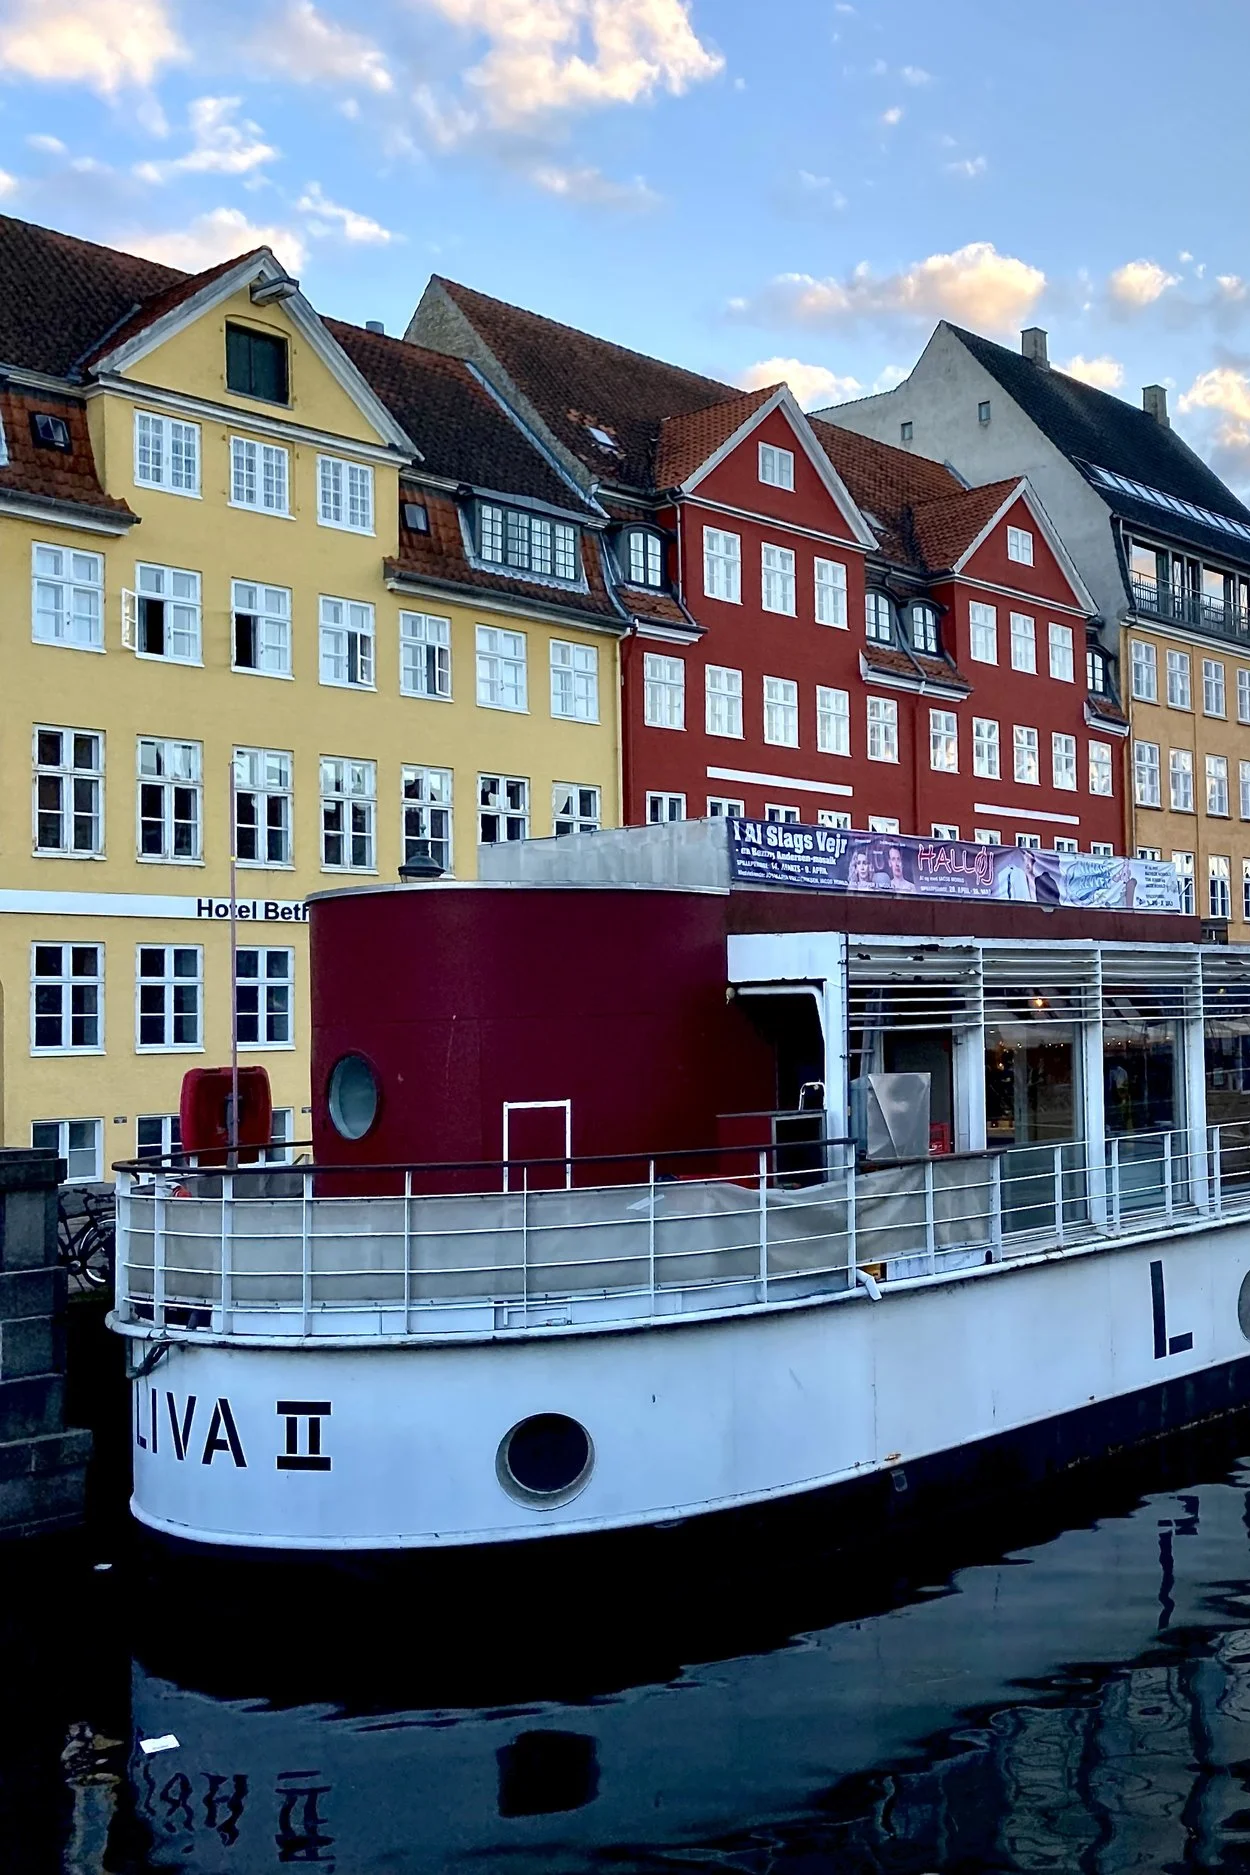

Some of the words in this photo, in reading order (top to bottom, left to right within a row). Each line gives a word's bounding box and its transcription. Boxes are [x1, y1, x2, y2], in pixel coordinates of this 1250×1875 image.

[766, 826, 813, 854] Slags
[816, 831, 847, 859] Vejr
[918, 844, 994, 886] HALLØJ
[135, 1380, 248, 1469] LIVA
